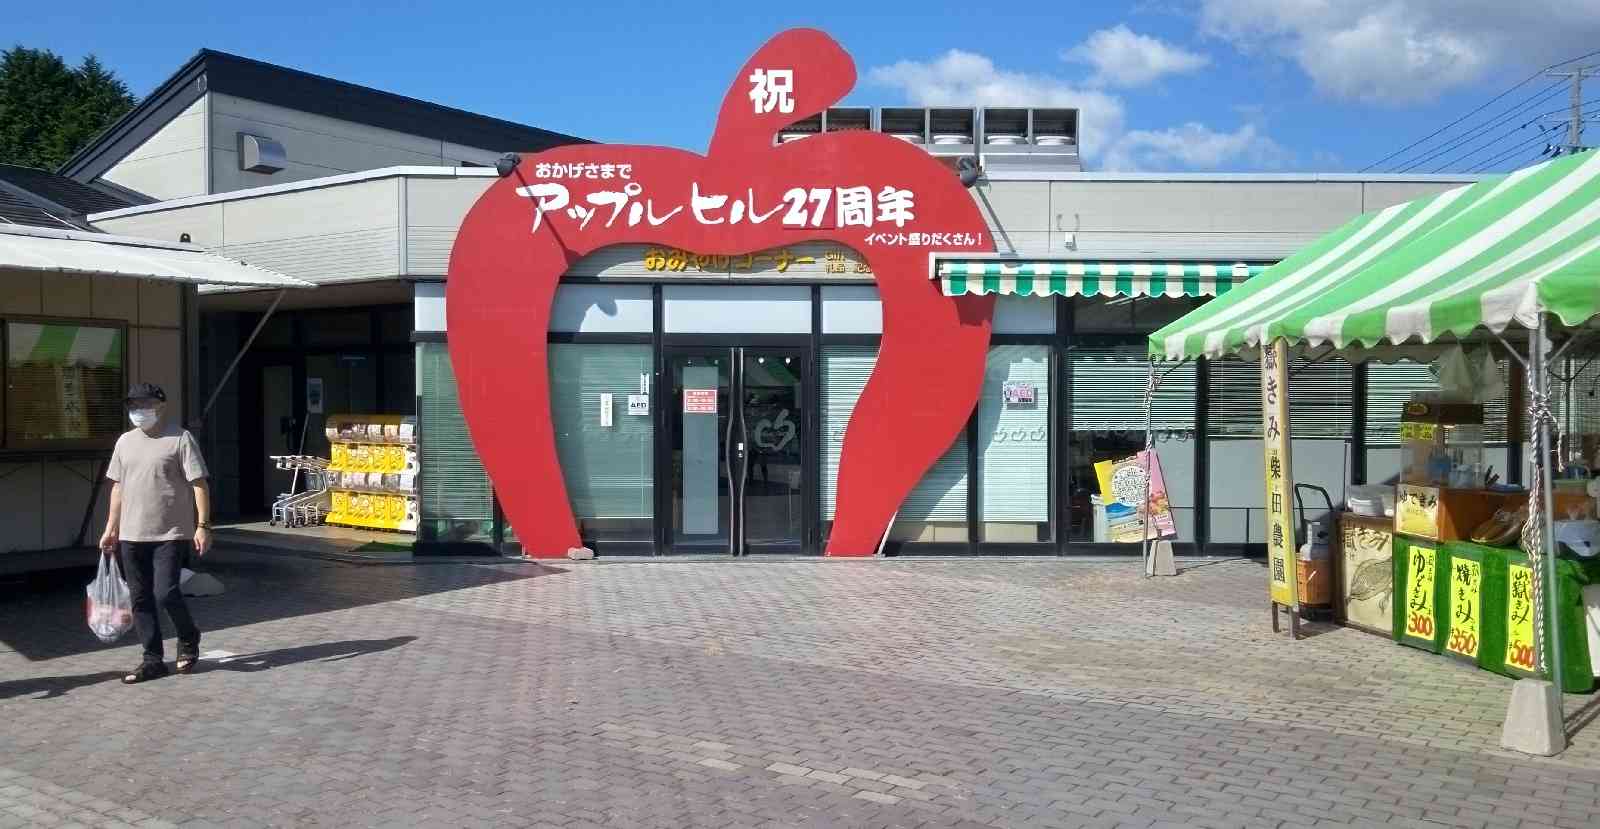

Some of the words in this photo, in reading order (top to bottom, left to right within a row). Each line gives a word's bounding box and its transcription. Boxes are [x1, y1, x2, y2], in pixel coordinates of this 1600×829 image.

[749, 69, 795, 114] 祝
[535, 163, 632, 179] おかげさまで
